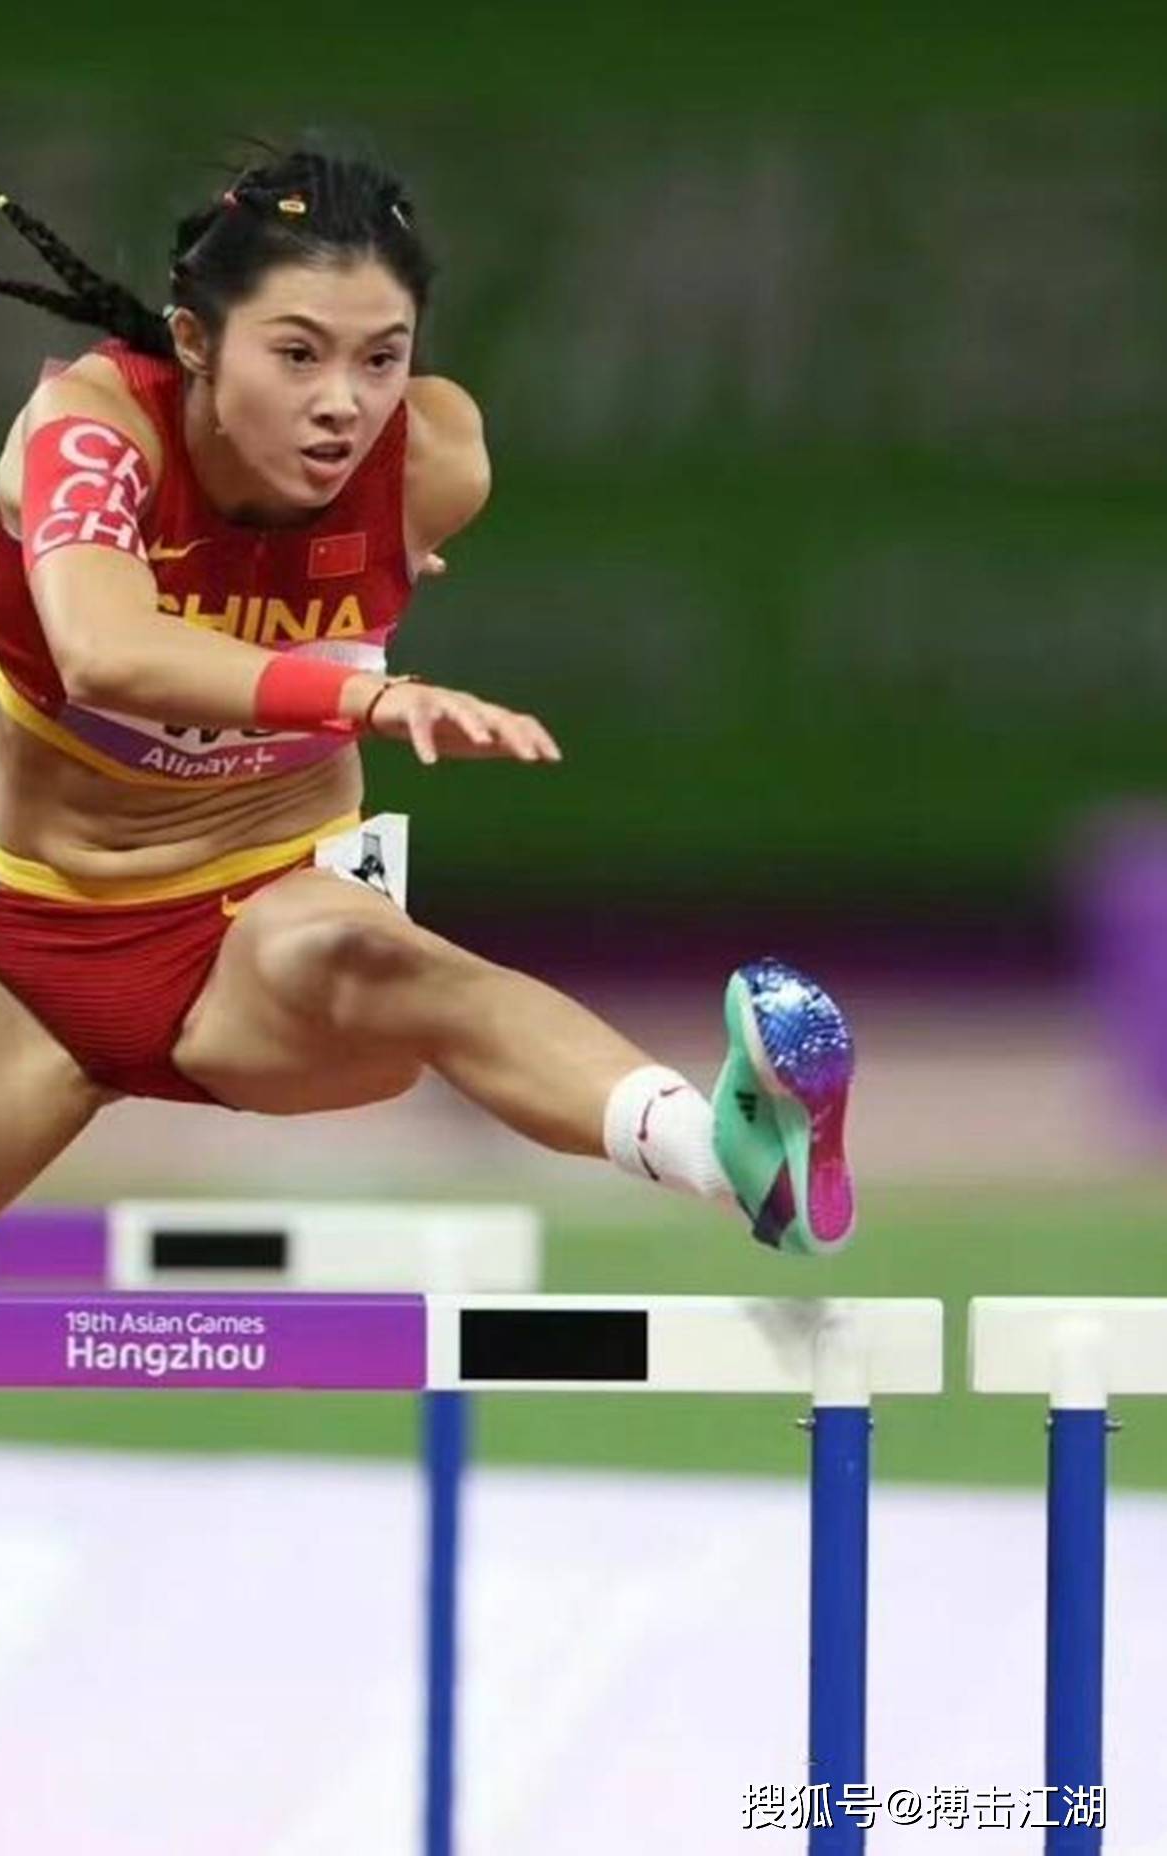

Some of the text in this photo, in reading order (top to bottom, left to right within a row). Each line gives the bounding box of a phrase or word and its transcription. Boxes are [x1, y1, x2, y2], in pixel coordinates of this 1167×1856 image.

[65, 1312, 265, 1334] 19th Asian Games
[66, 1336, 266, 1376] Hangzhou
